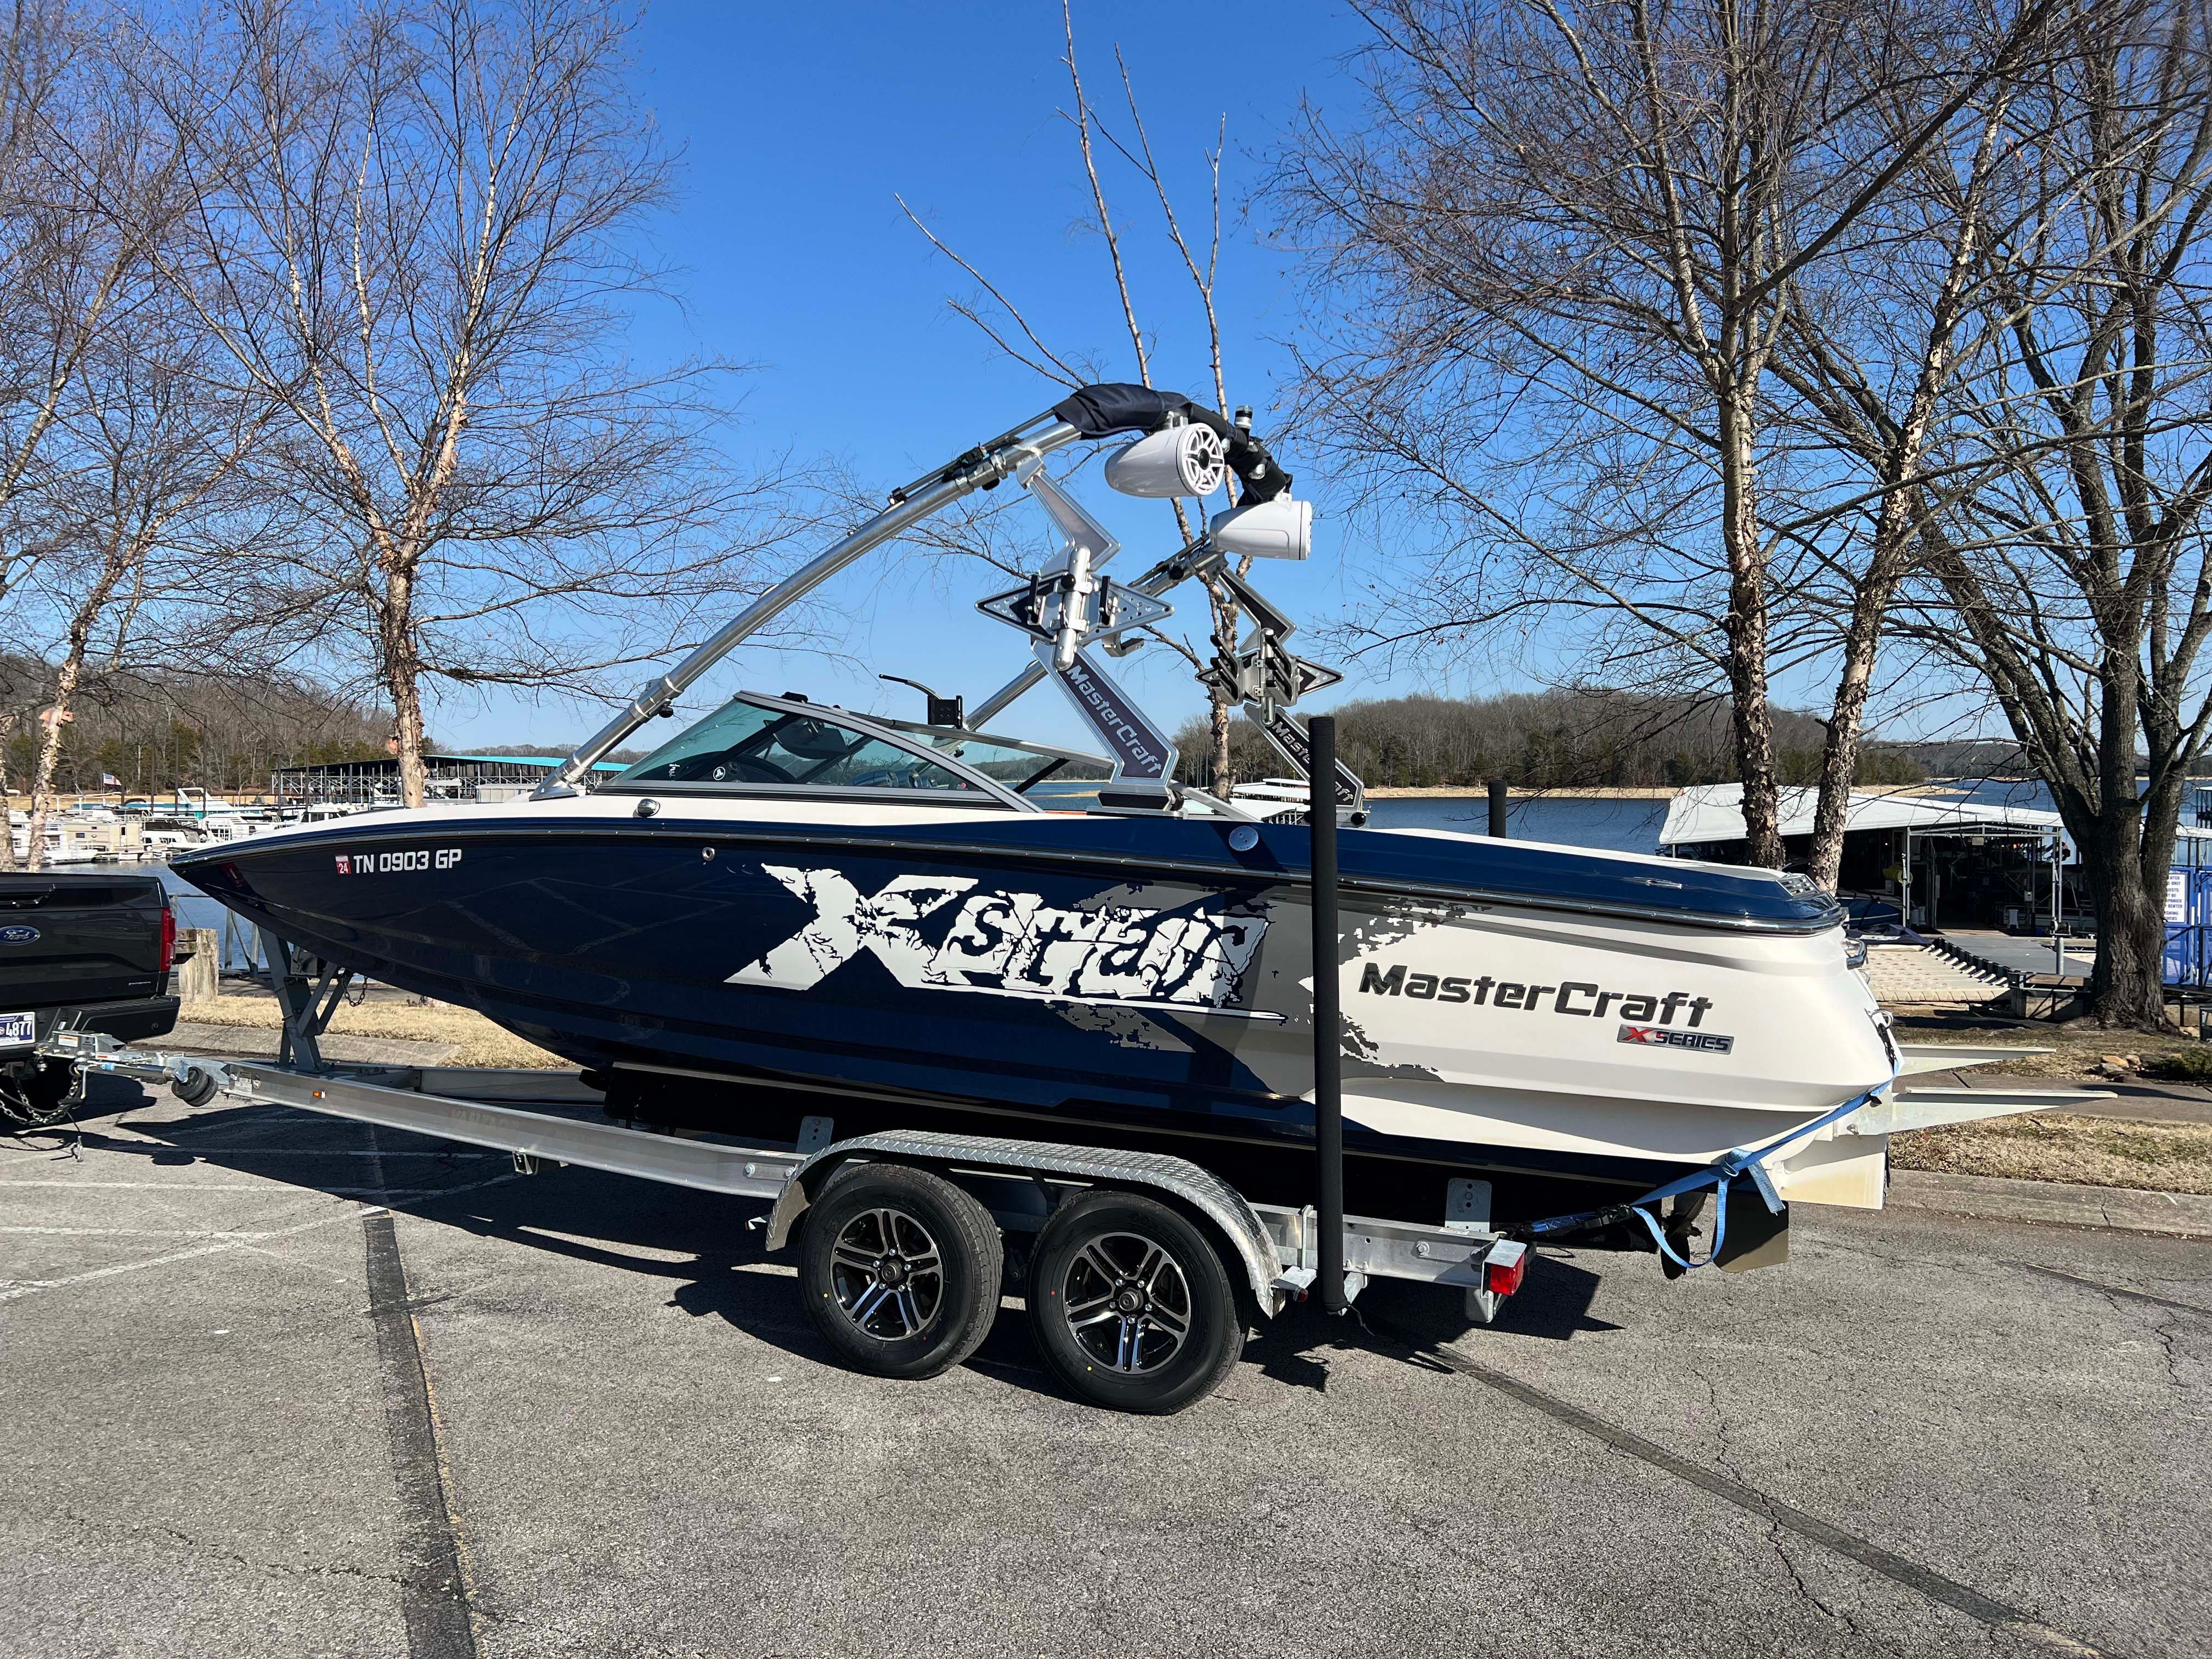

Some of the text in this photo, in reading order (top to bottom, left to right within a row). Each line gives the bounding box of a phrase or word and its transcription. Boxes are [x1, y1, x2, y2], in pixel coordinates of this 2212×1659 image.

[1066, 664, 1162, 773] MasterCraft
[1272, 721, 1353, 802] Masteaft
[338, 862, 348, 873] 24
[353, 849, 462, 873] TN 0903 GP
[1359, 962, 1713, 1028] MasterCraft
[6, 1021, 32, 1036] 4877
[1621, 1026, 1730, 1051] X SERIES
